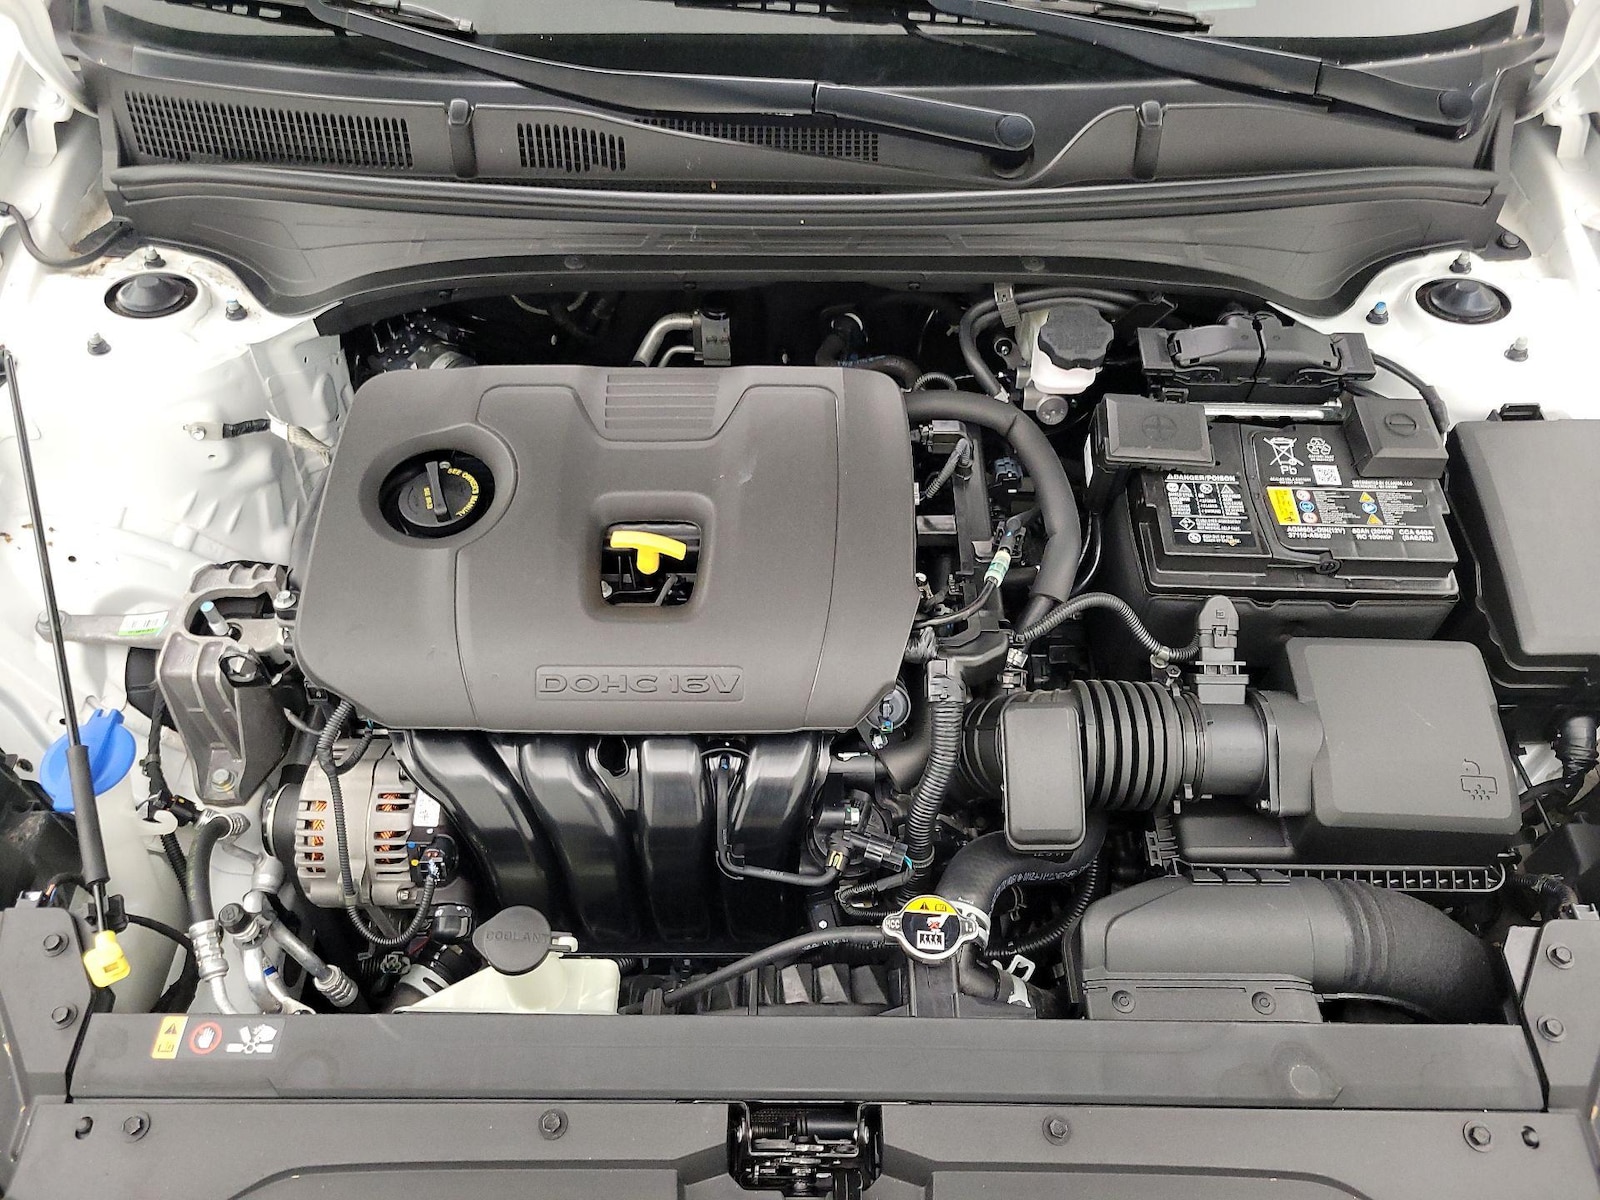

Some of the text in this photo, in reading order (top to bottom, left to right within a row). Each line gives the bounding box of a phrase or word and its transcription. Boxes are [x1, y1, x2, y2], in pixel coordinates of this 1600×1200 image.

[1280, 465, 1297, 475] Pb
[538, 674, 741, 693] DOHC 16V
[486, 930, 549, 943] COOLANT
